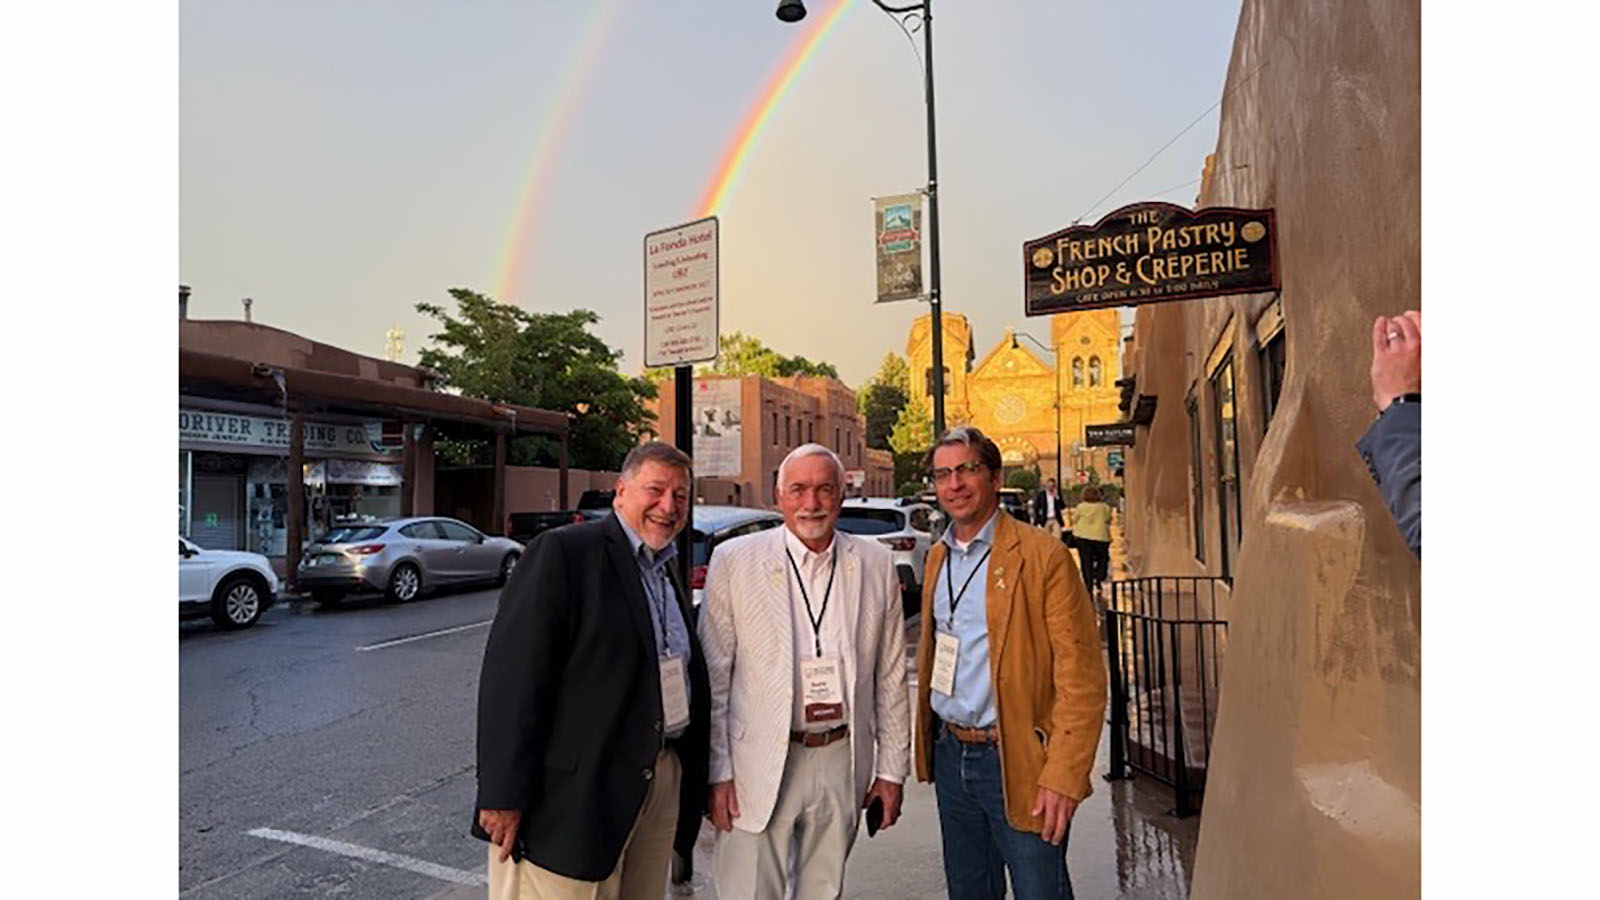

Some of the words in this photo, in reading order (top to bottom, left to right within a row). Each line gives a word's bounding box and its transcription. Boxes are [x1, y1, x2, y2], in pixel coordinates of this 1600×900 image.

[1128, 210, 1160, 226] THE
[661, 237, 687, 252] Fonda
[689, 230, 712, 245] Hotel
[1056, 232, 1139, 265] FRENCH
[1146, 220, 1236, 249] PASTRY
[1050, 264, 1111, 295] SHOP
[1115, 261, 1133, 285] &
[263, 421, 337, 442] TRDING
